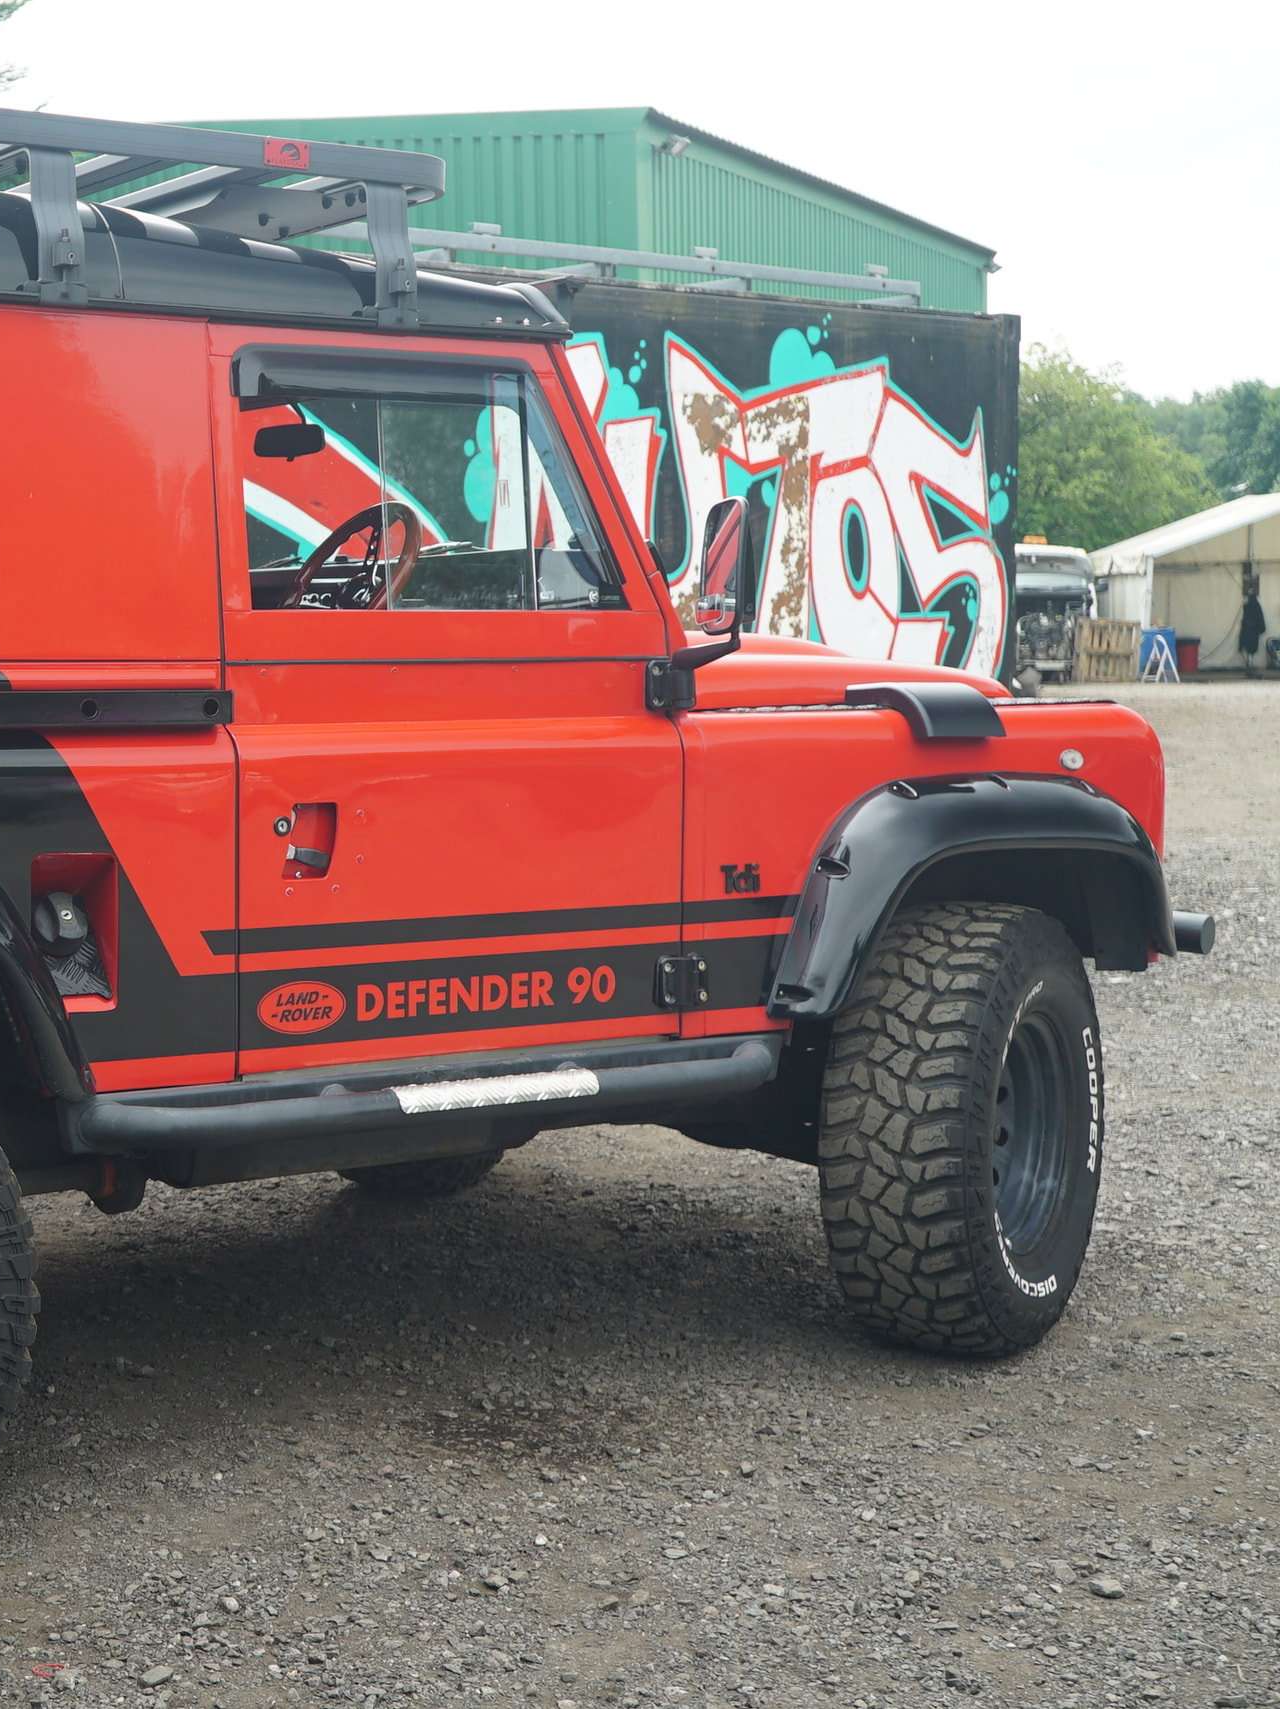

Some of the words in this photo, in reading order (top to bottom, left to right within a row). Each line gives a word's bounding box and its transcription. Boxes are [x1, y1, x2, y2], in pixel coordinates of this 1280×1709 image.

[719, 863, 761, 895] Tdi
[275, 991, 320, 1007] LAND
[356, 970, 554, 1022] DEFENDER
[567, 965, 616, 1004] 90
[279, 1006, 333, 1023] ROVER
[1082, 1026, 1098, 1173] COOPER
